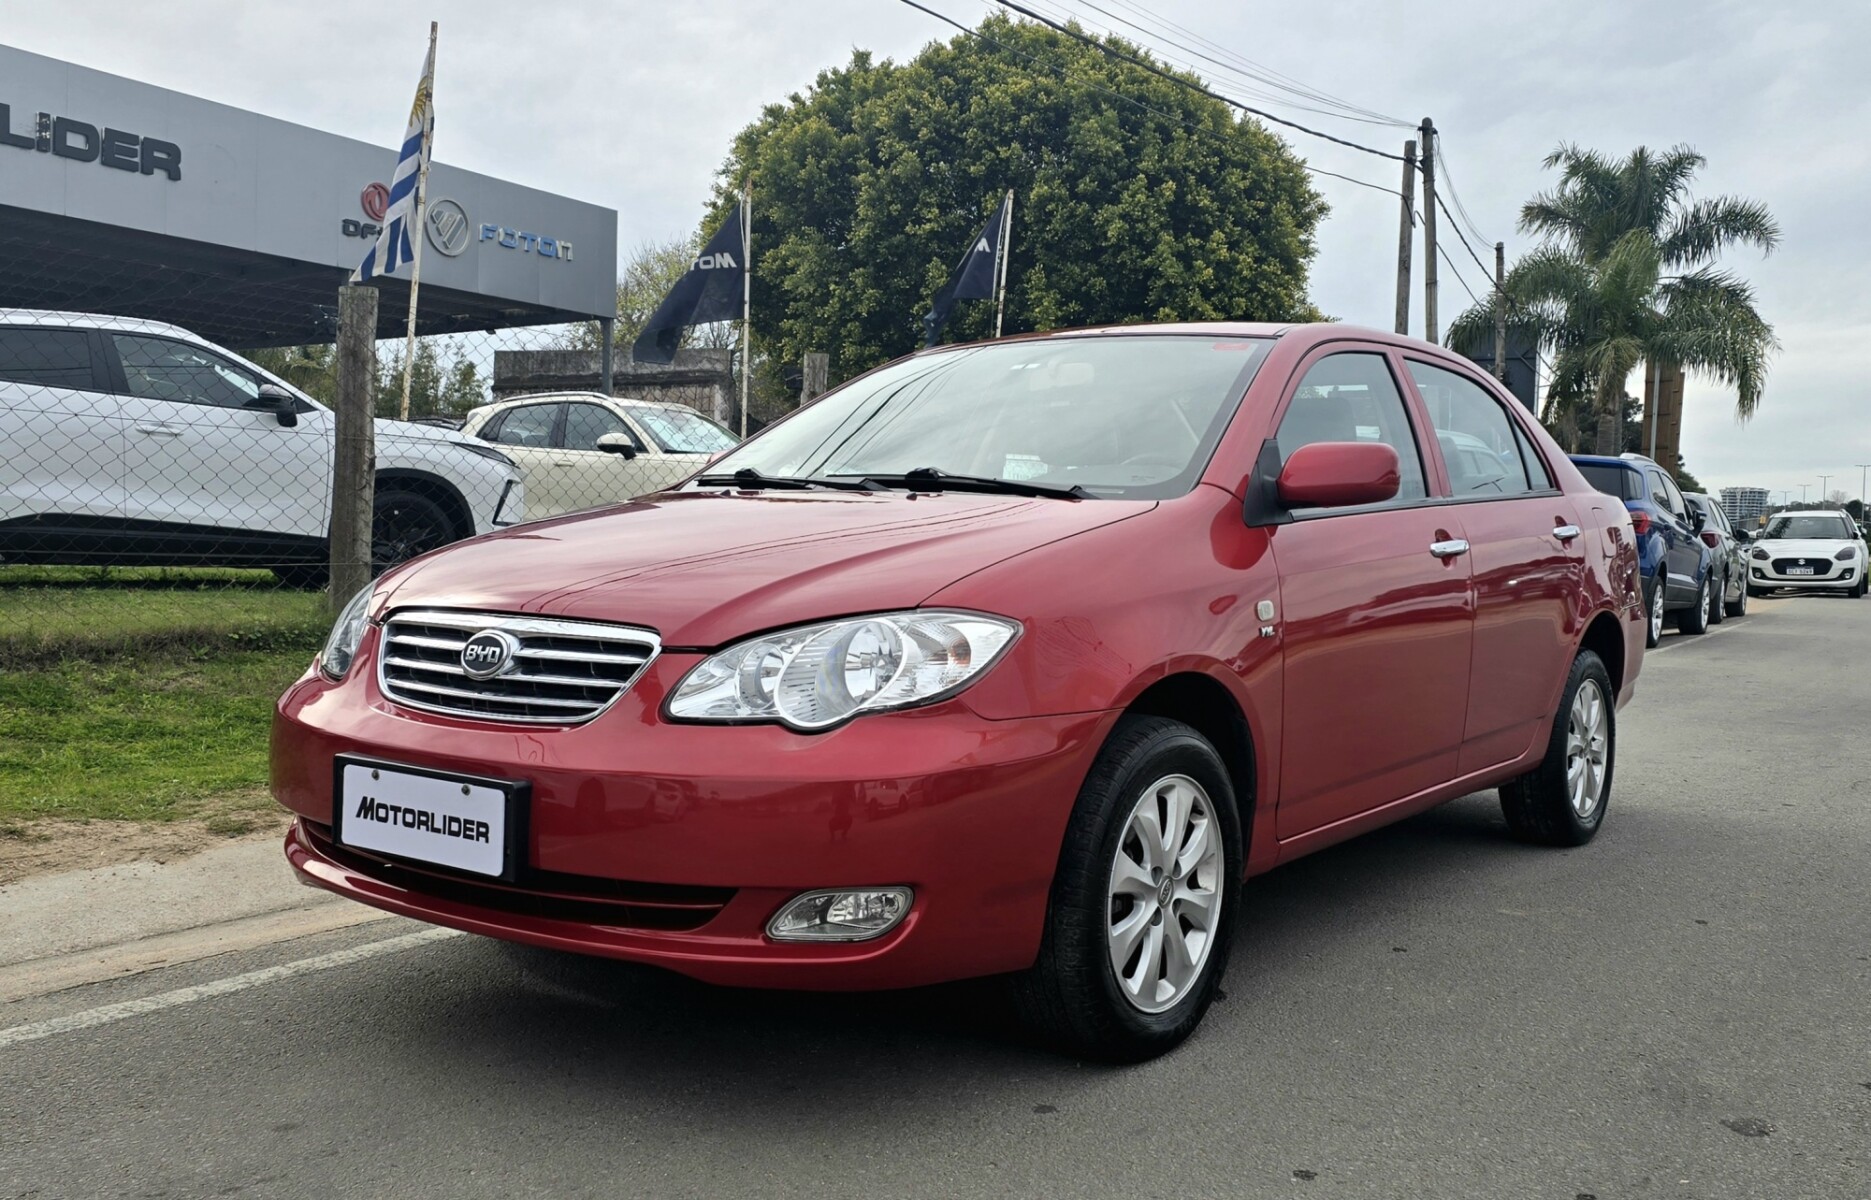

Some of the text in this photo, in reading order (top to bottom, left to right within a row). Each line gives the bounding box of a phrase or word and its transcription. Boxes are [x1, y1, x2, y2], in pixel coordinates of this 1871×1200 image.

[0, 103, 181, 181] LIDER
[479, 223, 573, 261] FOTON
[465, 644, 501, 663] BYD
[356, 796, 489, 843] MOTORLIDER
